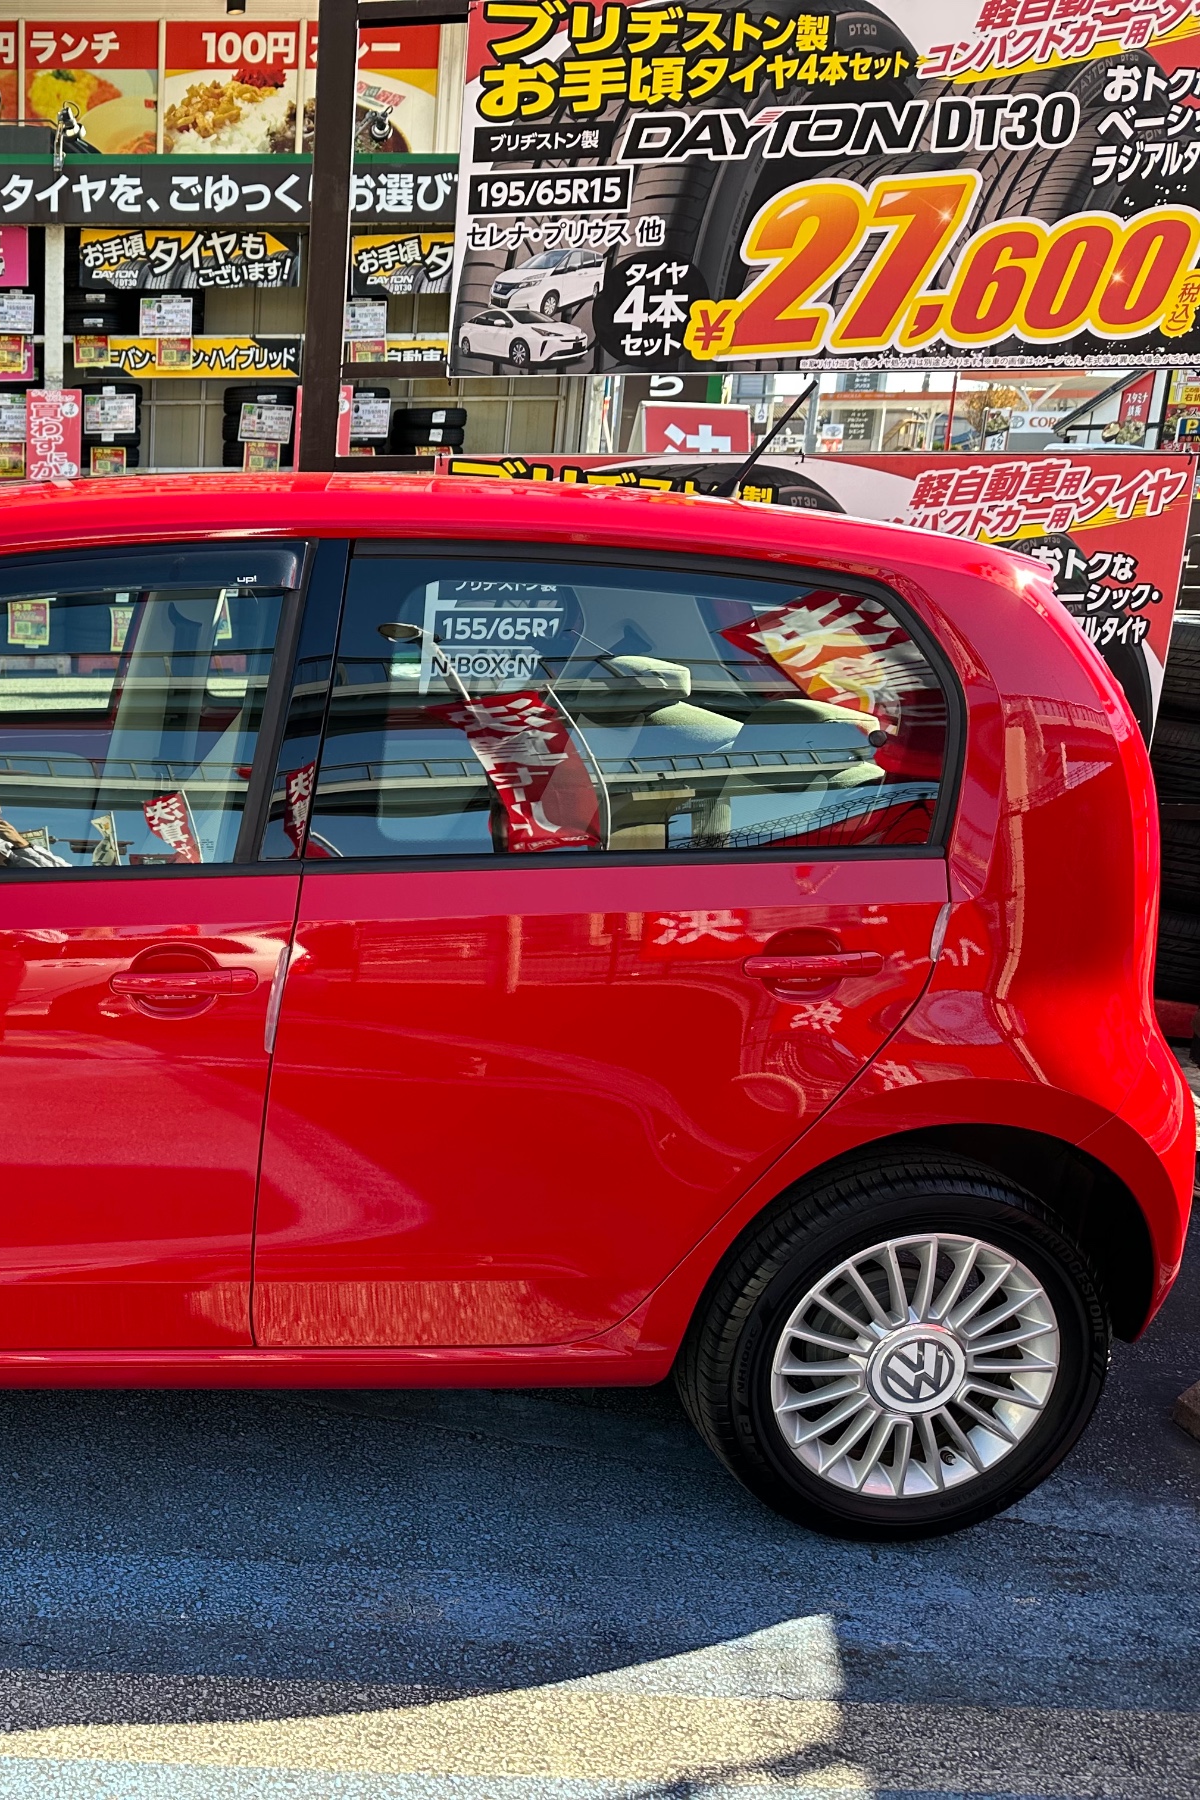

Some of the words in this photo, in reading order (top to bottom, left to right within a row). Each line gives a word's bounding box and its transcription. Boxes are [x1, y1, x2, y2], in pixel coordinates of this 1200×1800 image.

[486, 1, 829, 56] ブリヂストン製
[922, 15, 1152, 76] コンパクトカー用
[29, 31, 121, 64] ランチ
[201, 31, 296, 65] 100円
[480, 51, 909, 116] お手頃タイヤ4本セット
[1103, 65, 1200, 103] おトク
[490, 129, 600, 152] ブリヂストン製
[620, 103, 922, 161] DAYTON
[932, 95, 1081, 152] DT30
[477, 176, 622, 209] 195/65R15
[467, 218, 631, 249] セレナ・プリウス
[636, 215, 665, 247] 他
[625, 261, 689, 283] タイヤ
[612, 288, 688, 329] 4本
[621, 333, 682, 357] セット
[909, 460, 1091, 510] 軽自動車用
[1076, 468, 1187, 520] タイヤ
[236, 574, 258, 584] up!
